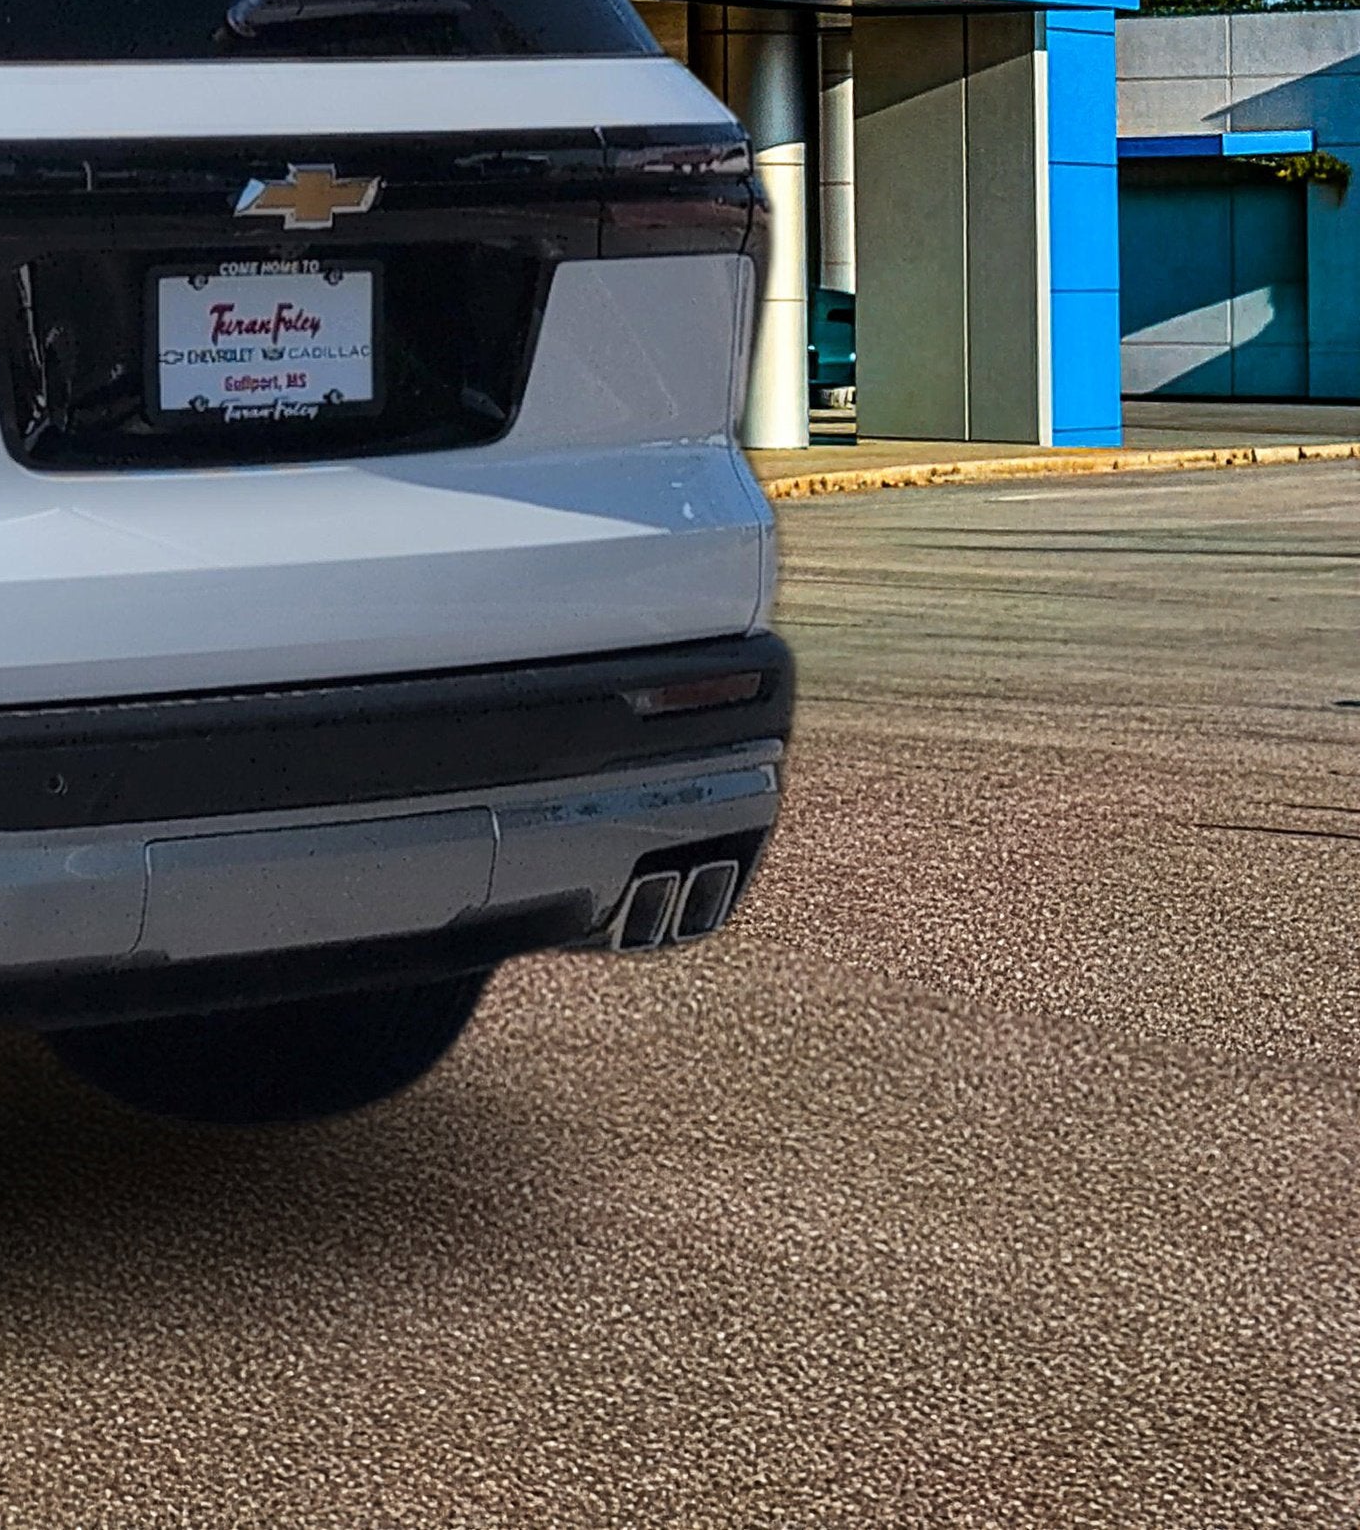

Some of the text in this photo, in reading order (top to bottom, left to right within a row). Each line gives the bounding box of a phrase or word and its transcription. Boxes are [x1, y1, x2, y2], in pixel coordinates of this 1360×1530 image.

[219, 259, 320, 275] COME HOME TO
[187, 345, 371, 364] CHEVROLET CADILLAC
[286, 373, 307, 388] MS
